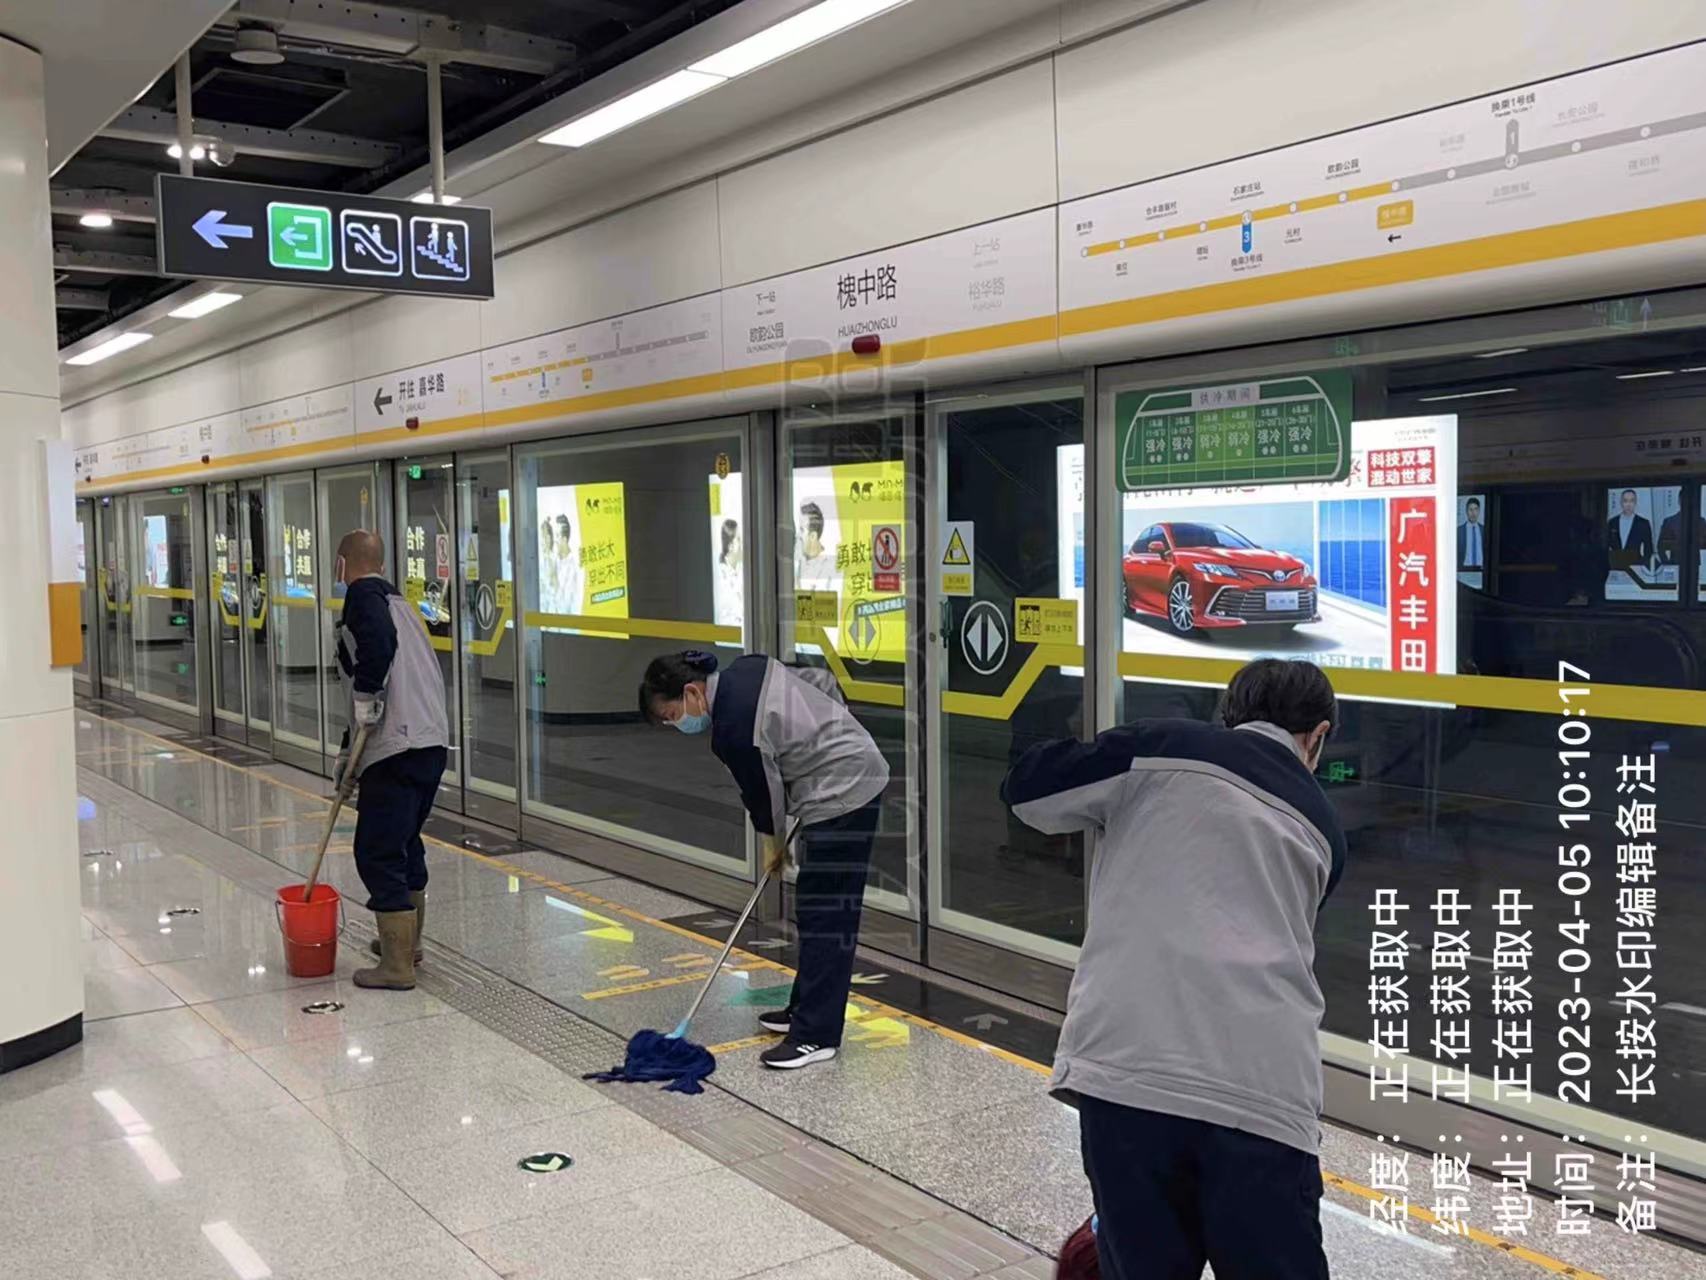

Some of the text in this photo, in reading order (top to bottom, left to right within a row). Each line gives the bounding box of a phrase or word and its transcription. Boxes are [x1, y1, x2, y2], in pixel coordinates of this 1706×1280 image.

[837, 263, 898, 310] 槐中路
[838, 316, 898, 337] HUAIZHONGLU
[1369, 449, 1433, 469] 科技双擎
[1369, 467, 1434, 487] 混动世家
[1396, 508, 1430, 672] 广汽丰田
